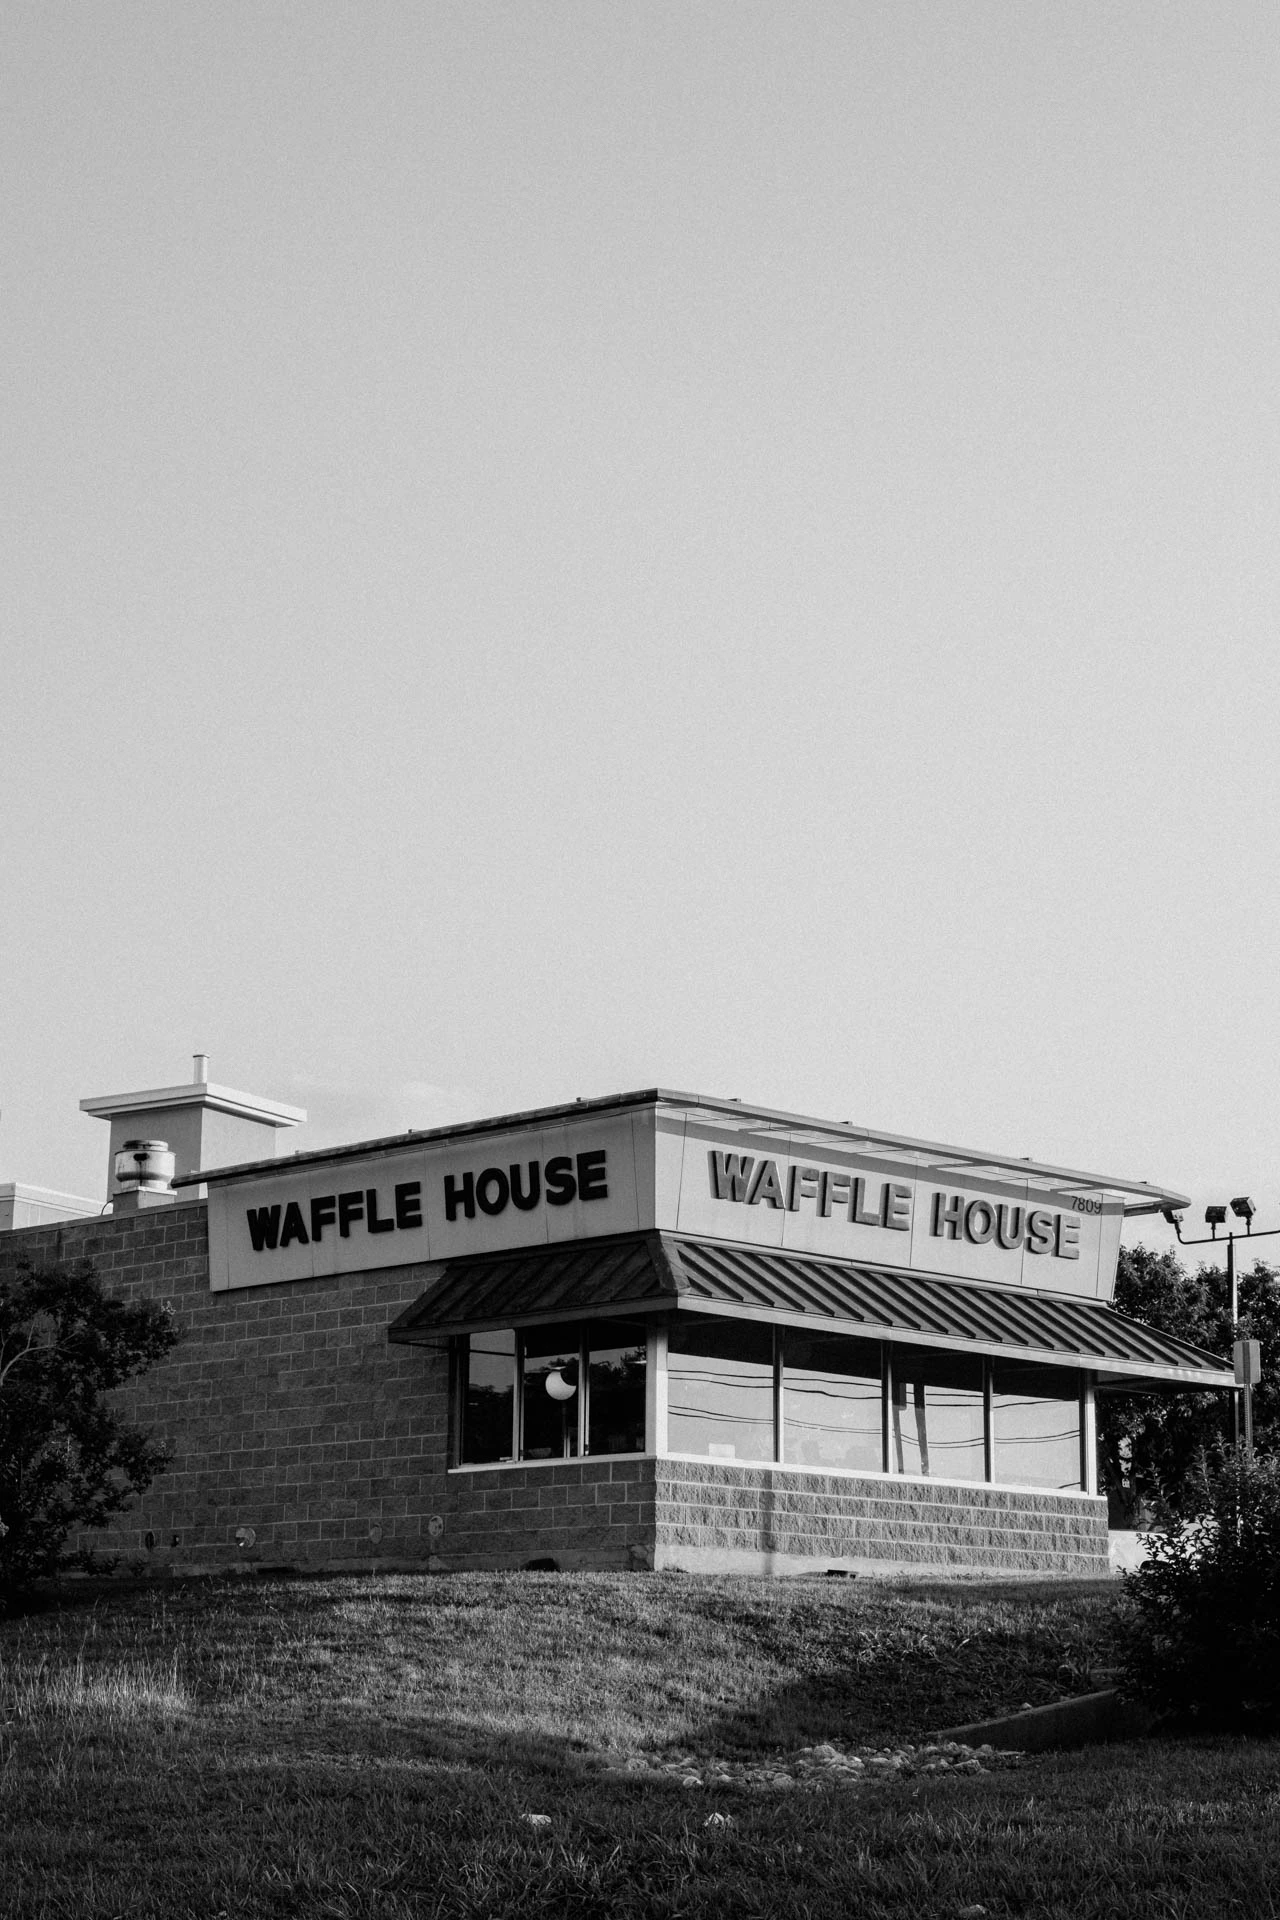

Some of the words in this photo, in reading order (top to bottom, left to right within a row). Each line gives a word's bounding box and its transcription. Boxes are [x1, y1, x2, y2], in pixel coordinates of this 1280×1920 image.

[247, 1181, 423, 1252] WAFFLE
[444, 1149, 608, 1221] HOUSE
[708, 1150, 912, 1231] WAFFLE
[929, 1192, 1081, 1259] HOUSE
[1071, 1195, 1101, 1214] 7809
